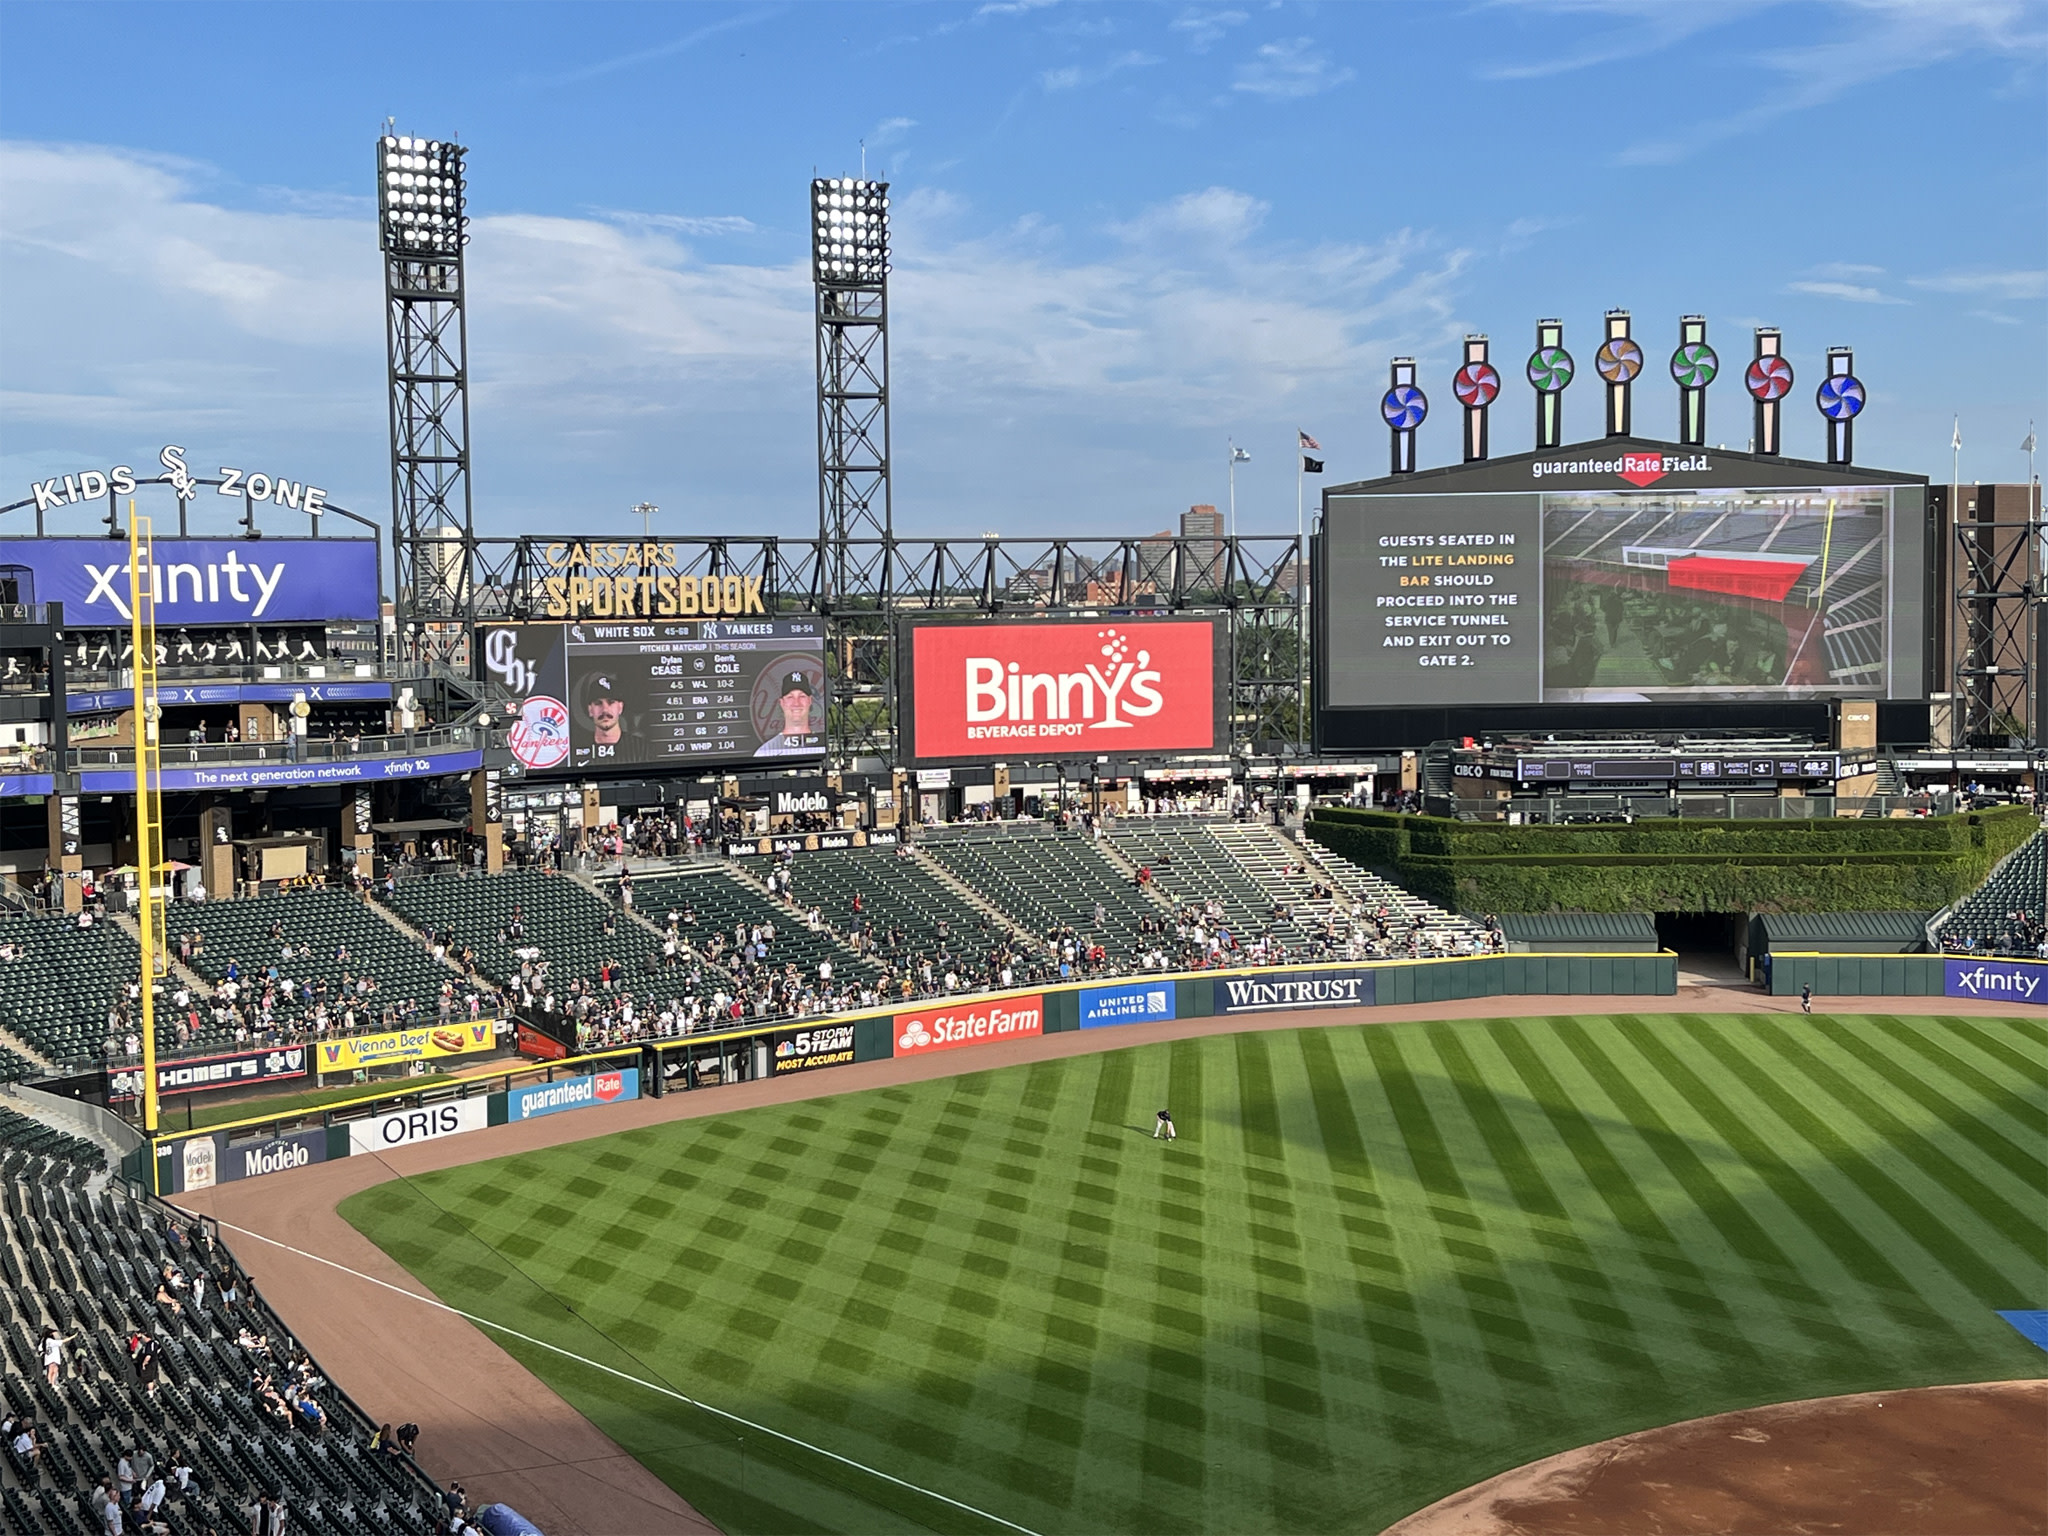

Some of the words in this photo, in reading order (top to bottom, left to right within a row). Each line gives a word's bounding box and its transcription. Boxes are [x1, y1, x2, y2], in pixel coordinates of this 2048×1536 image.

[1532, 458, 1622, 478] guaranteed
[1625, 457, 1660, 472] Rate
[32, 465, 137, 511] KIDS
[217, 467, 327, 516] ZONE
[1379, 535, 1434, 547] GUESTS
[1438, 534, 1494, 546] SEATED
[1499, 534, 1515, 545] IN
[545, 543, 676, 568] CAESARS
[1380, 556, 1408, 567] THE
[1412, 554, 1444, 566] LITE
[1448, 554, 1514, 566] LANDING
[1400, 575, 1430, 587] BAR
[1434, 574, 1494, 586] SHOULD
[546, 575, 765, 617] SPORTSBOOK
[1376, 595, 1444, 607] PROCEED
[1449, 594, 1484, 606] INTO
[1489, 594, 1518, 606] THE
[1385, 615, 1446, 627] SERVICE
[1451, 614, 1509, 626] TUNNEL
[594, 626, 630, 638] WHITE
[633, 626, 656, 637] SOX
[725, 624, 774, 635] YANKEES
[1383, 635, 1414, 647] AND
[1418, 634, 1452, 646] EXIT
[1456, 634, 1487, 646] OUT
[1490, 634, 1510, 646] TO
[640, 644, 671, 653] PITCHER
[672, 643, 707, 652] MATCHUP
[660, 656, 682, 666] Dylan
[1419, 654, 1456, 666] GATE
[1461, 654, 1474, 666] 2.
[651, 666, 683, 675] CEASE
[714, 664, 740, 674] COLE
[670, 681, 684, 689] 4-5
[692, 680, 708, 688] W-L
[717, 680, 734, 688] 10-2
[692, 696, 708, 704] ERA
[696, 712, 705, 720] IP
[674, 728, 684, 736] 23
[696, 727, 707, 735] GS
[718, 726, 728, 734] 23
[968, 724, 1036, 739] BEVERAGE
[1039, 723, 1084, 736] DEPOT
[690, 742, 712, 750] WHIP
[784, 736, 800, 747] 45
[598, 745, 616, 757] 84
[194, 772, 218, 783] The
[220, 771, 248, 782] next
[251, 768, 315, 784] generation
[318, 764, 362, 778] network
[384, 760, 414, 776] xfinity
[1454, 764, 1474, 776] CIBC
[778, 792, 828, 812] Modelo
[822, 838, 848, 848] Modelo
[870, 834, 896, 844] Modelo
[729, 844, 756, 855] Modelo
[1958, 967, 2040, 998] xfinity
[1226, 978, 1362, 1005] WINTRUST
[1099, 994, 1144, 1008] UNITED
[1088, 1004, 1146, 1018] AIRLINES
[812, 1026, 854, 1040] STORM
[348, 1038, 396, 1054] Vienna
[401, 1032, 430, 1047] Beef
[796, 1032, 810, 1054] 5
[811, 1036, 852, 1052] TEAM
[776, 1058, 804, 1070] MOST
[804, 1051, 854, 1067] ACCURATE
[522, 1078, 592, 1118] guaranteed
[596, 1078, 620, 1092] Rate
[383, 1106, 458, 1144] ORIS
[156, 1145, 172, 1158] 330
[186, 1150, 214, 1166] Modelo
[245, 1143, 309, 1177] Modelo
